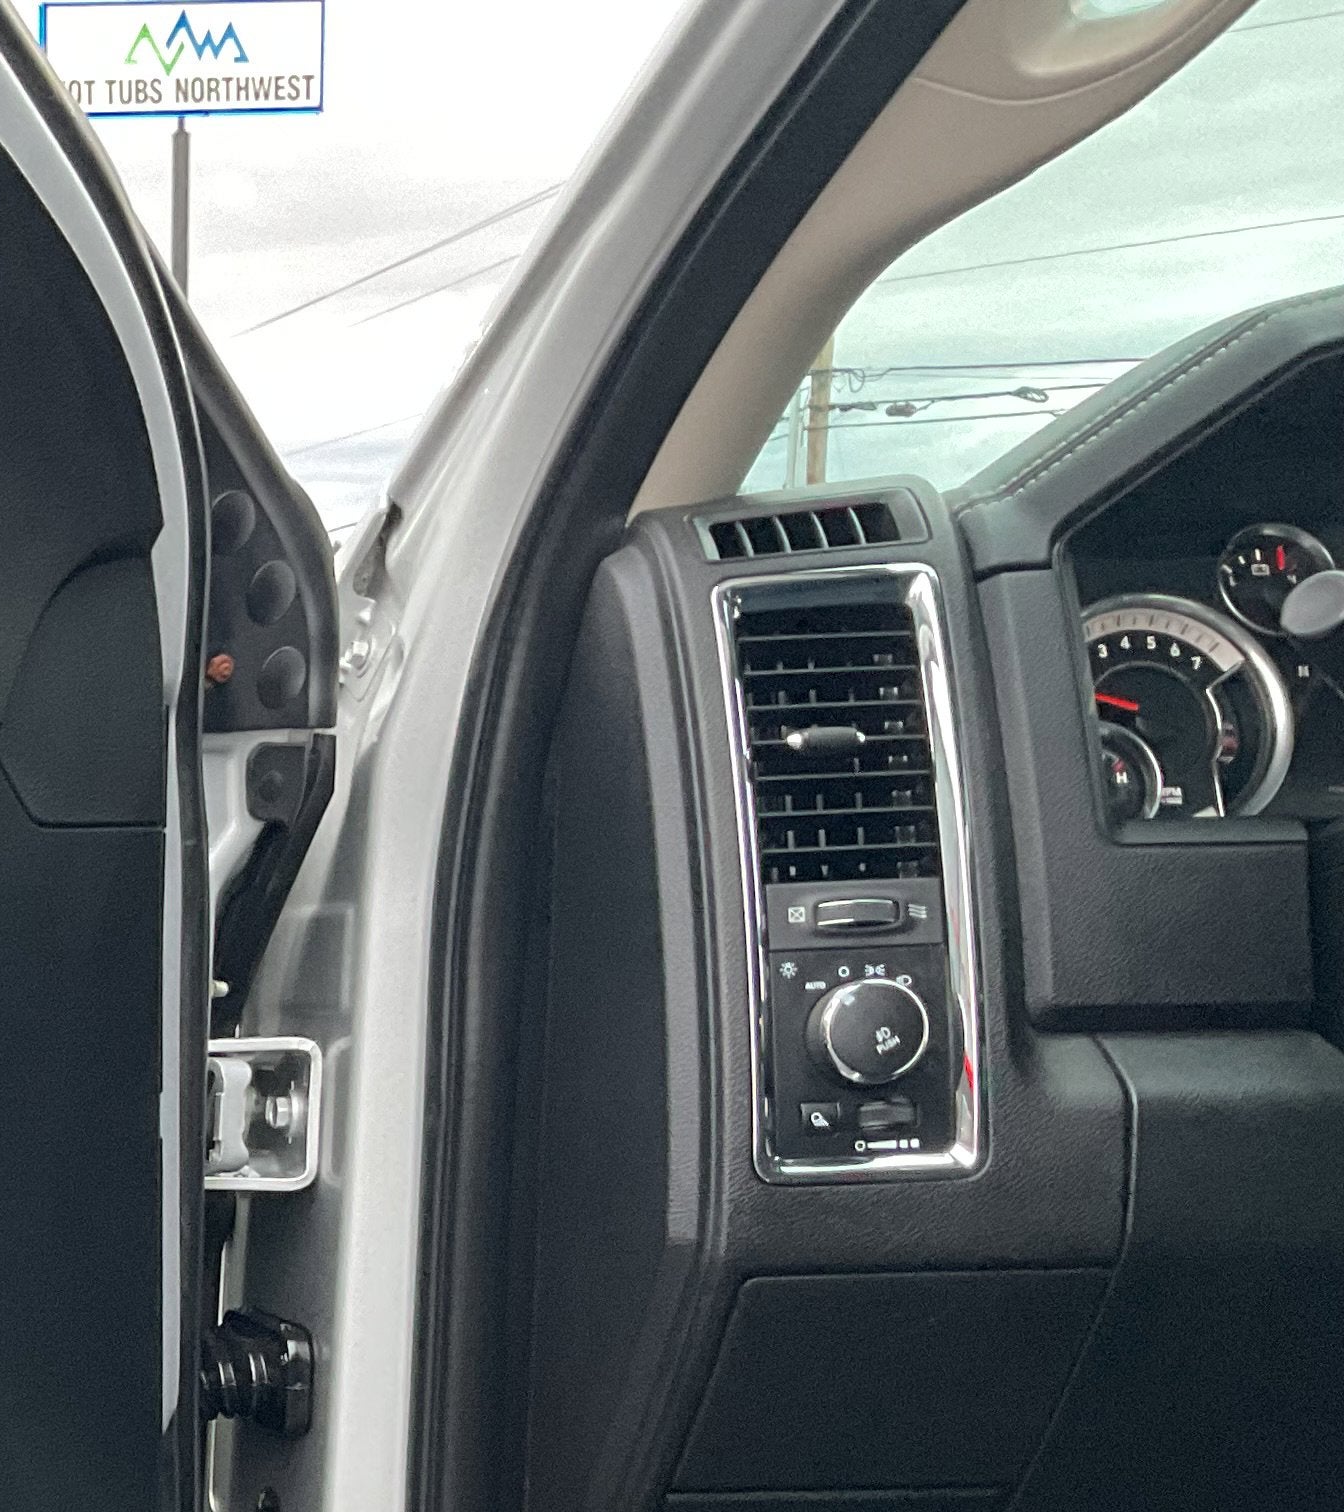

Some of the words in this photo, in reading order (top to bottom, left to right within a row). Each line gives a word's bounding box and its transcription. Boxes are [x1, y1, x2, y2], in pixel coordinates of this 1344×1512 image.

[61, 80, 96, 105] OT
[105, 78, 163, 105] TUBS
[175, 75, 315, 104] NORTHWEST
[1120, 635, 1131, 650] 4
[1146, 635, 1157, 650] 5
[1170, 642, 1181, 657] 6
[1191, 655, 1201, 670] 7
[1116, 772, 1128, 784] H
[805, 981, 826, 990] AUTO
